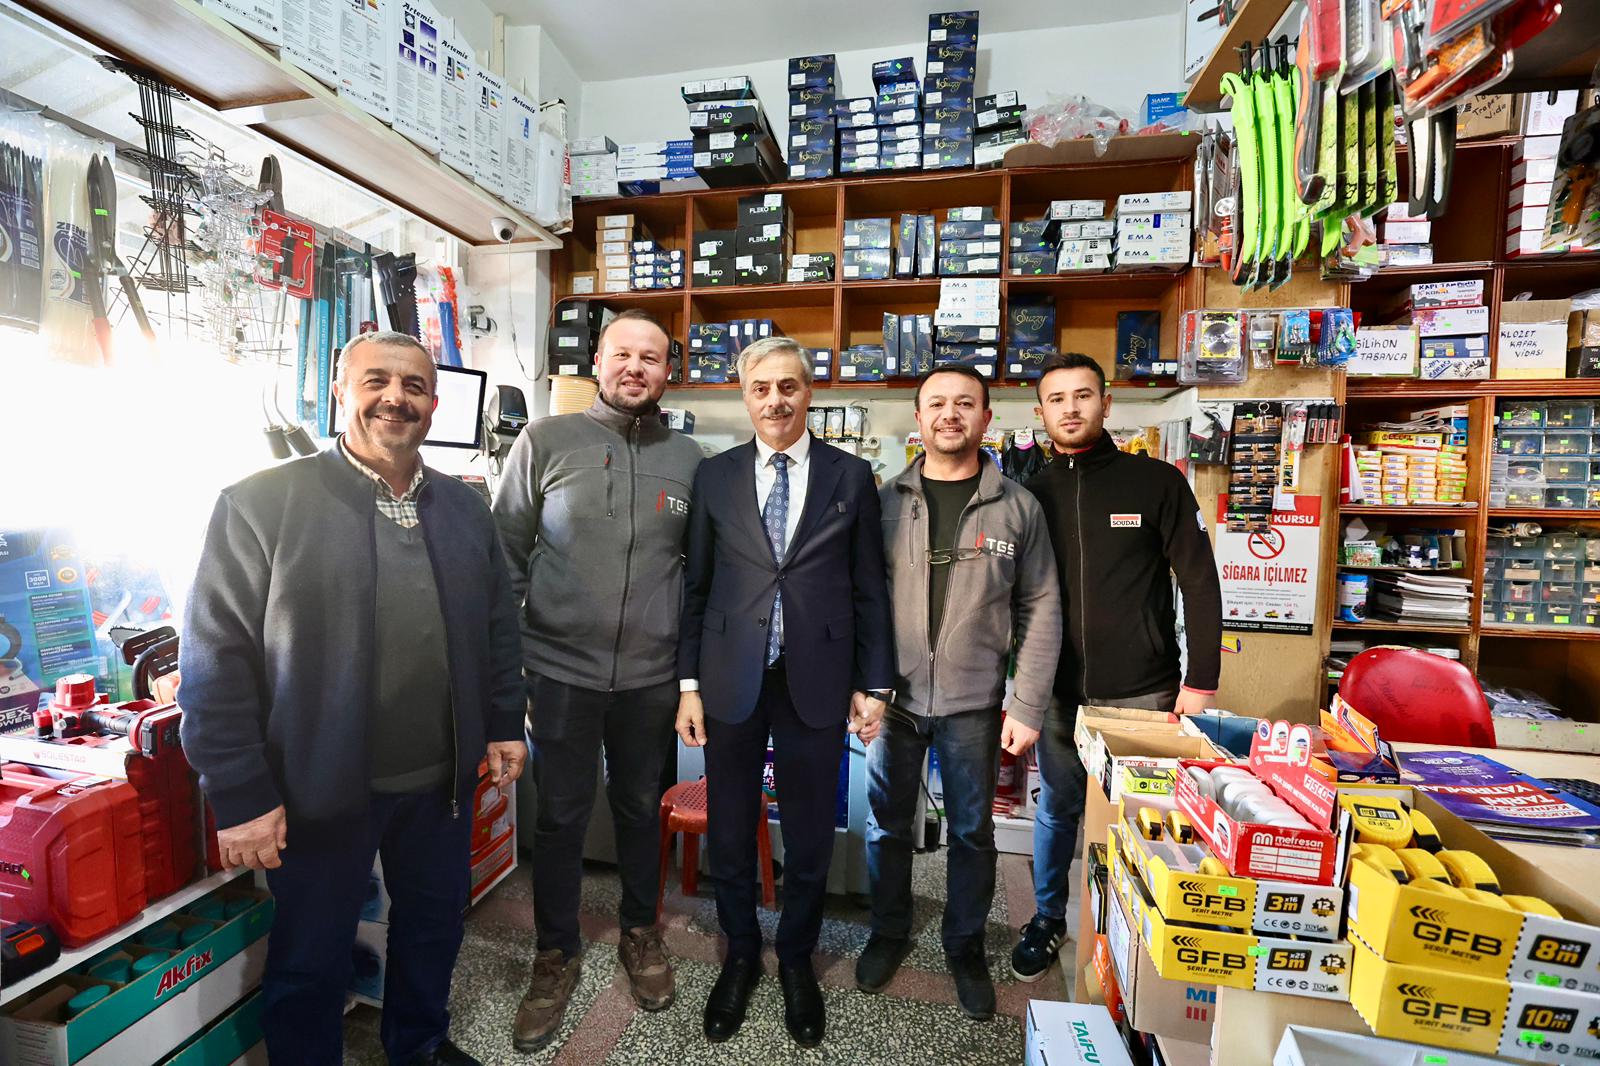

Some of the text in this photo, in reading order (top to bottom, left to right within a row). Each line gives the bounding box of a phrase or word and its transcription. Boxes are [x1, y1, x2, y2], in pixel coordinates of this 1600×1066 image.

[402, 2, 434, 25] Artemis
[441, 39, 468, 60] Artemis
[476, 71, 502, 89] Artemis
[512, 96, 536, 114] Artemis
[710, 112, 733, 120] FLEKO
[712, 152, 734, 160] FLEKO
[749, 206, 769, 214] FLEKO
[1015, 308, 1048, 330] Suzzy
[1500, 330, 1536, 338] KLOZET
[1360, 352, 1408, 361] TABANCA
[1273, 514, 1315, 524] KURSU
[985, 537, 1015, 556] TGS
[1222, 560, 1308, 586] SİGARA İÇİLMEZ
[1304, 777, 1328, 800] FISCO
[1480, 794, 1556, 806] TARİHİ
[1275, 836, 1324, 848] metresan
[1183, 892, 1246, 912] GFB
[1316, 900, 1331, 910] 12
[1412, 921, 1502, 957] GFB
[1177, 947, 1247, 970] GFB
[1326, 957, 1341, 967] 12
[154, 947, 213, 1000] Akfix
[1402, 998, 1492, 1027] GFB
